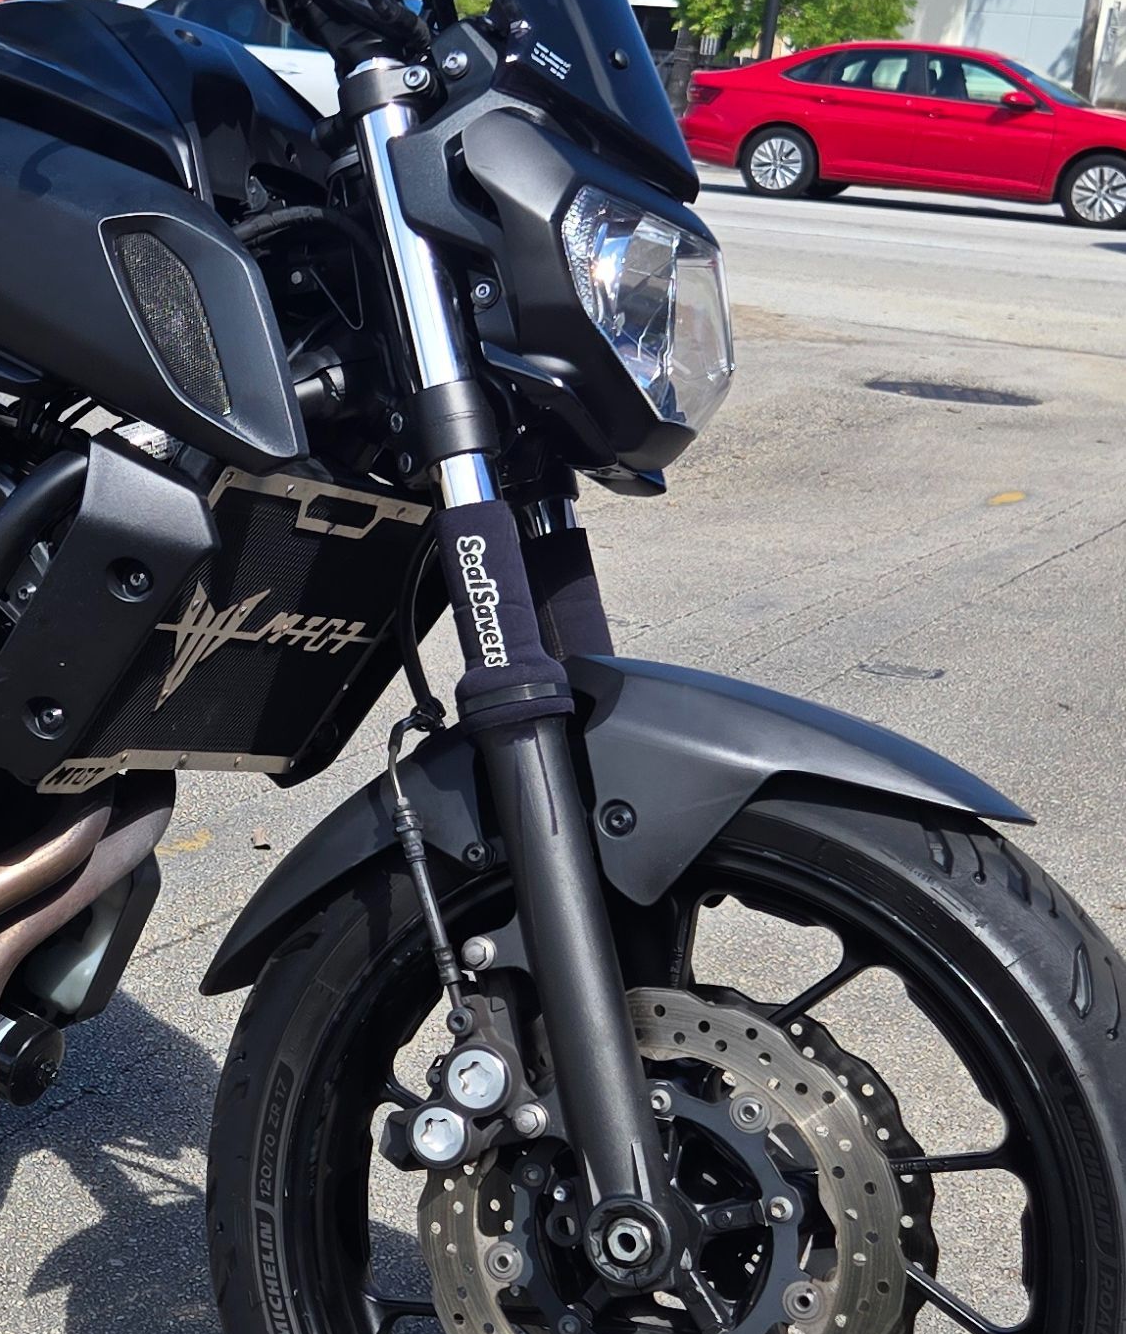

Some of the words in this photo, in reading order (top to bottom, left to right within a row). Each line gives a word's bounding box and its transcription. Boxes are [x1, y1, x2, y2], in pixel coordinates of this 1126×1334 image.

[456, 534, 508, 668] SealSavers
[265, 1101, 283, 1130] ZR
[273, 1078, 287, 1100] 17
[258, 1131, 276, 1198] 120/70
[1064, 1103, 1113, 1244] MICHELIN
